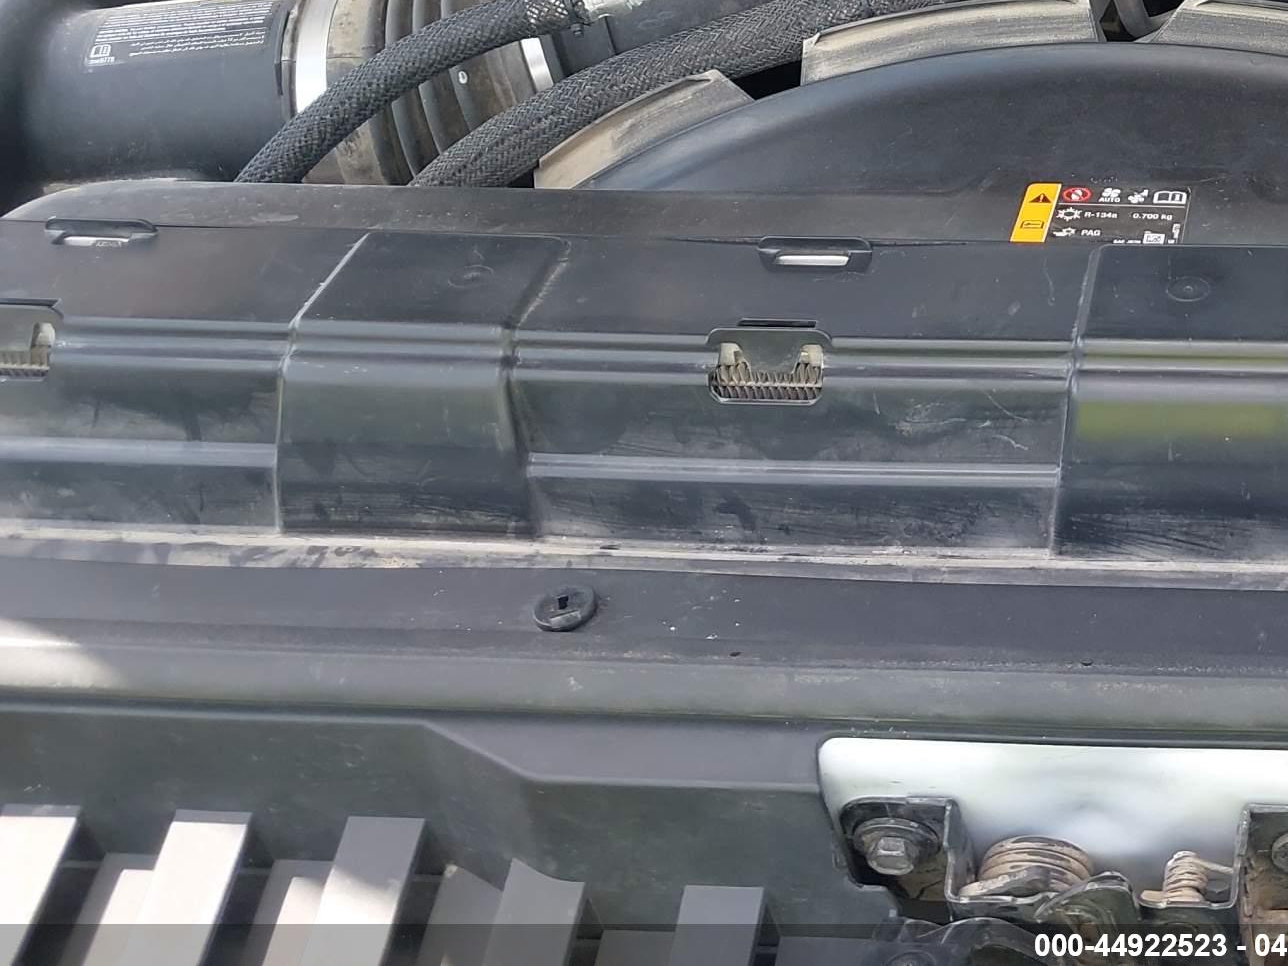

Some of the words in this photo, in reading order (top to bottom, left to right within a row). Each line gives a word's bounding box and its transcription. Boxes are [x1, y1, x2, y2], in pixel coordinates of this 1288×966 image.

[1132, 212, 1159, 220] 0.700
[1160, 213, 1173, 221] kg
[1080, 229, 1101, 237] PAG
